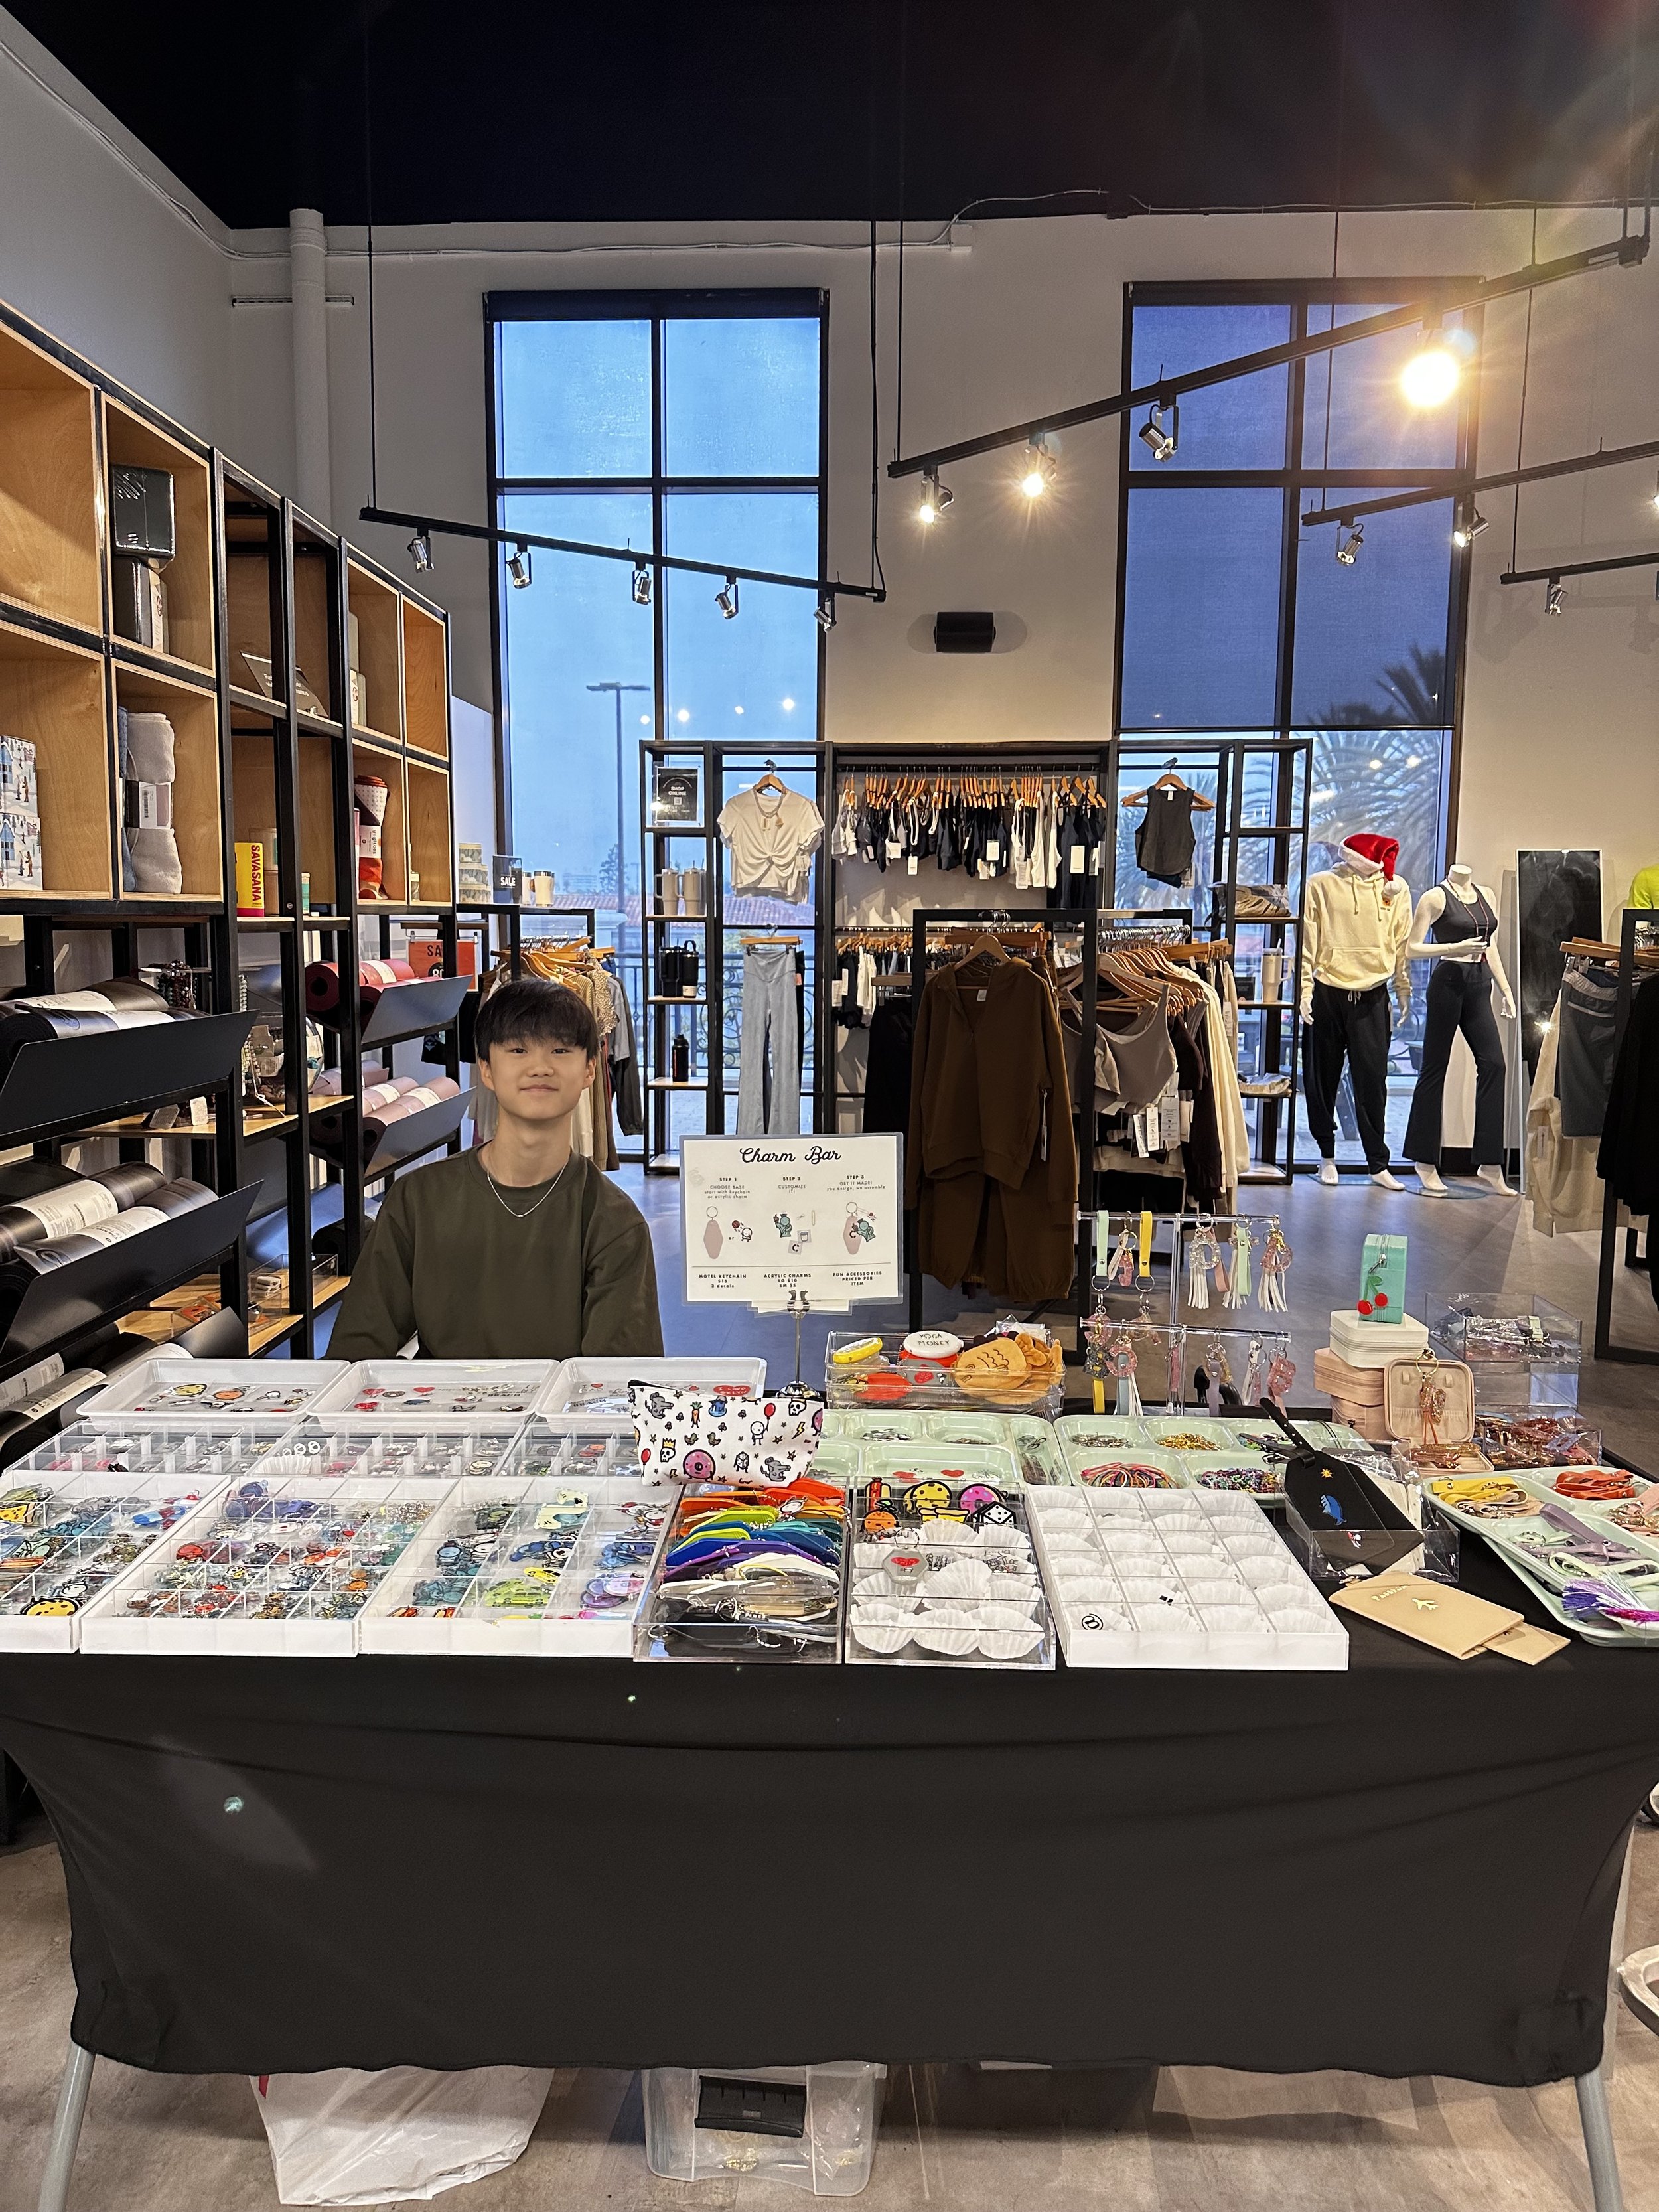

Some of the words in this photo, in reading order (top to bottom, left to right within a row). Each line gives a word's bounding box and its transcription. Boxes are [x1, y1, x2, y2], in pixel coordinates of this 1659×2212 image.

[251, 844, 262, 902] SAVASANA
[500, 876, 516, 887] SALE
[739, 1147, 796, 1163] Charm
[804, 1145, 842, 1165] Bar
